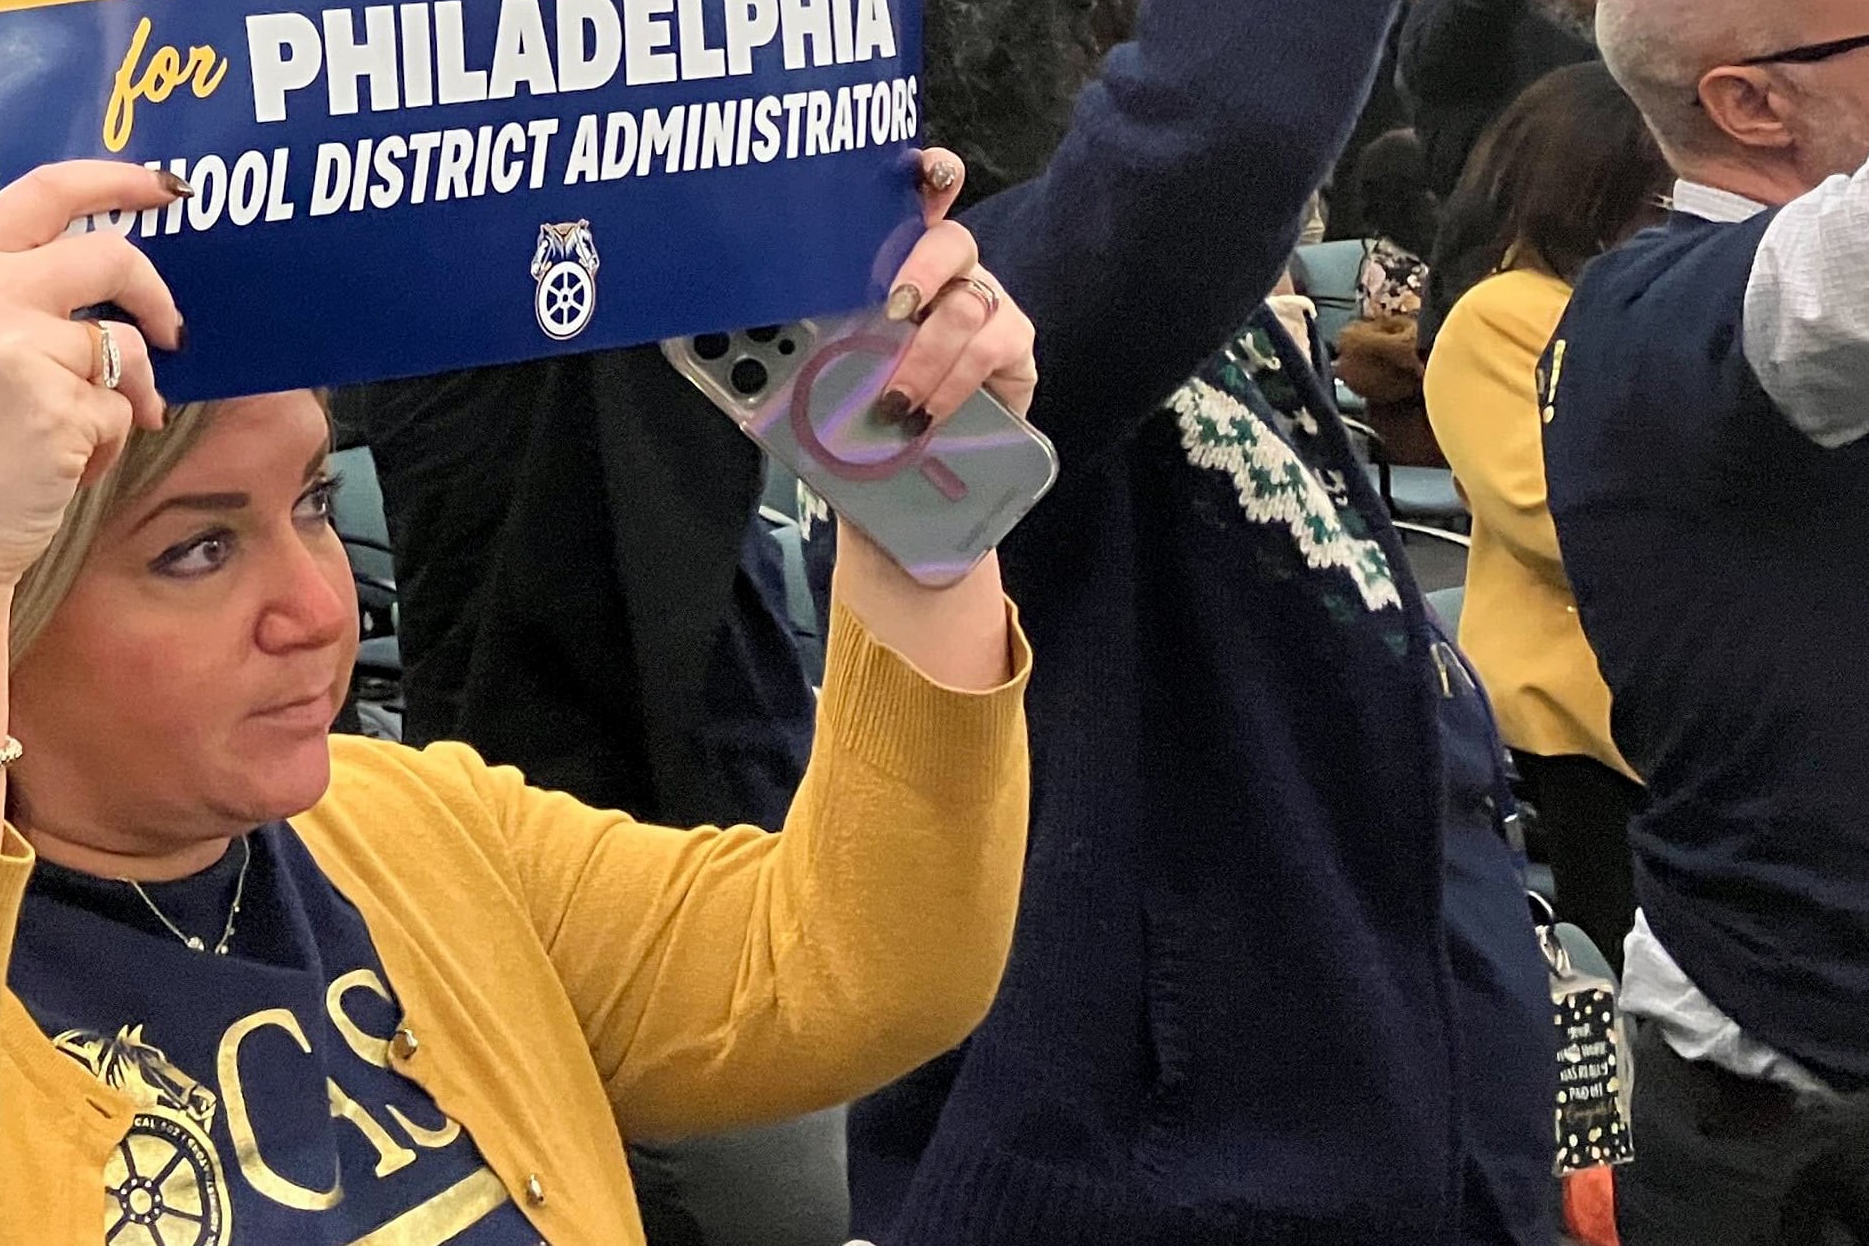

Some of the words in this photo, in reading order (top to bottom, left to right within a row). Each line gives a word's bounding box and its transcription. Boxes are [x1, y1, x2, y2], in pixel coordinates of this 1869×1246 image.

[64, 147, 295, 238] HOOL
[309, 119, 563, 218] DISTRICT
[564, 77, 919, 189] ADMINISTRATORS
[102, 17, 229, 152] for
